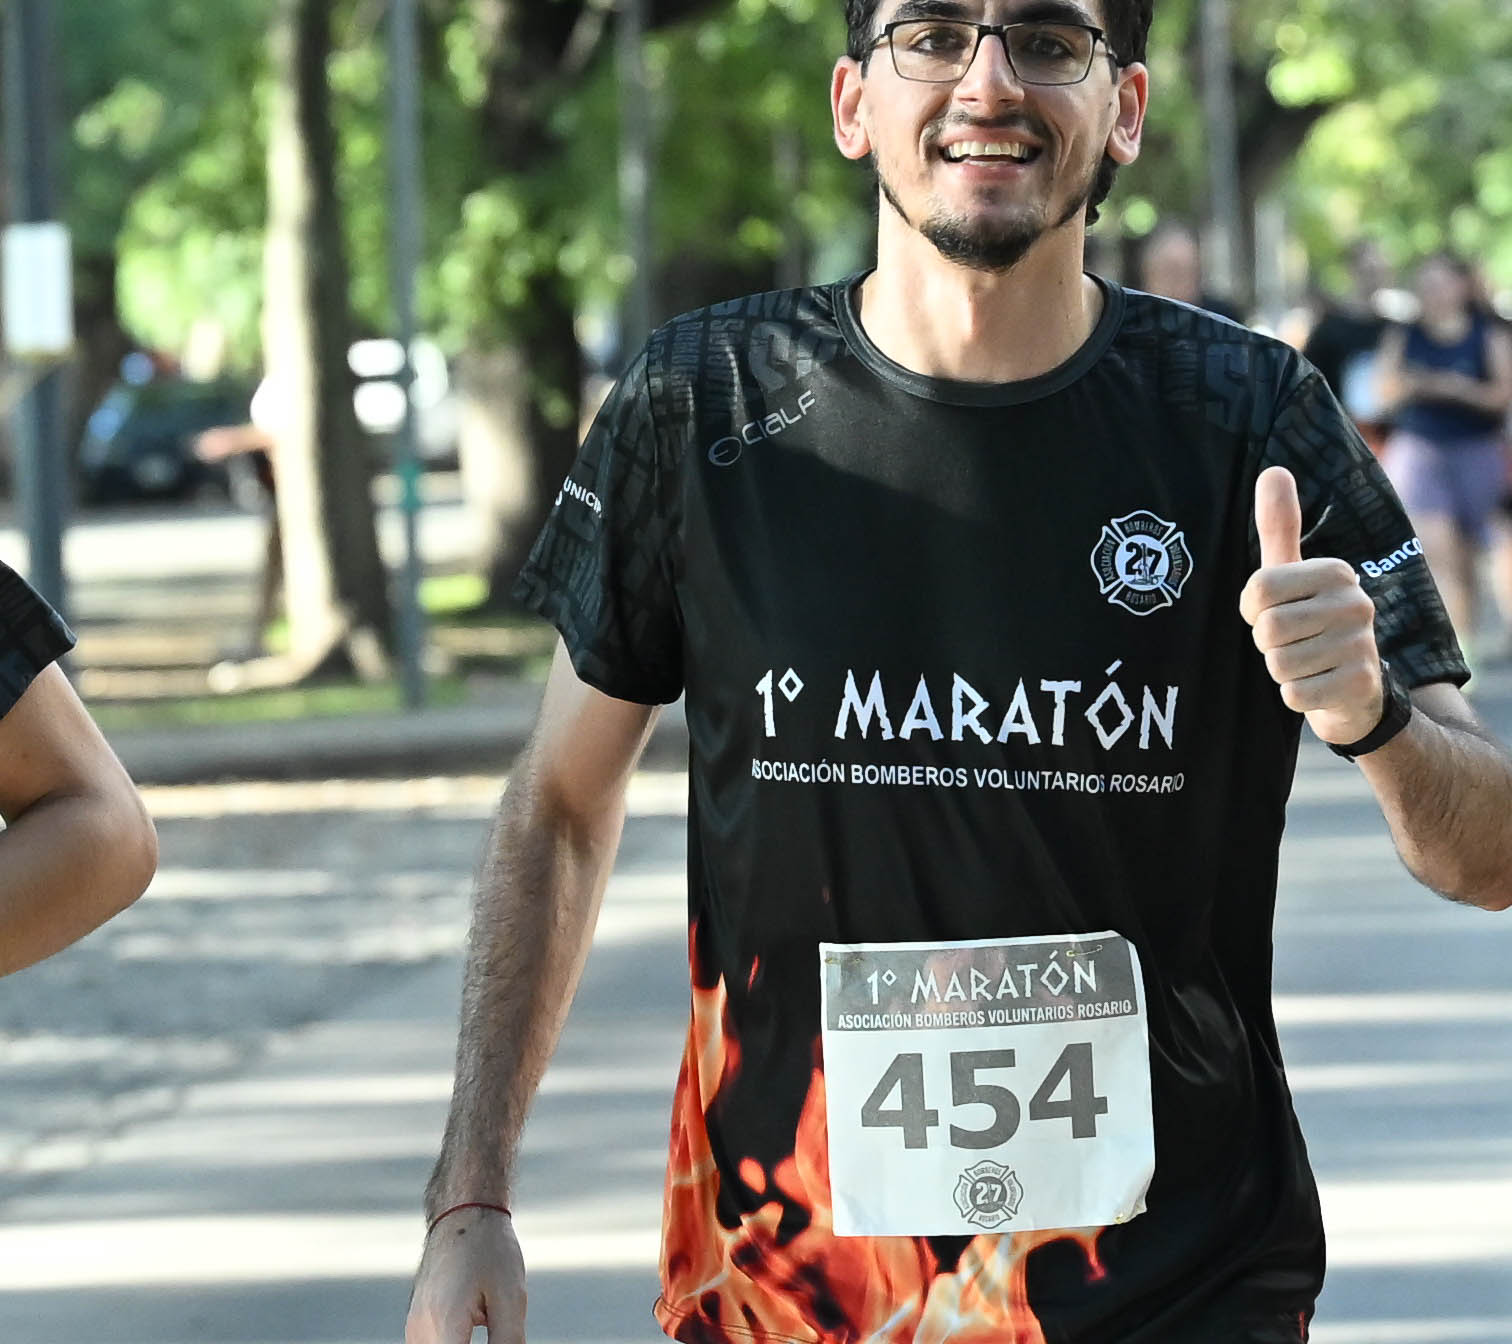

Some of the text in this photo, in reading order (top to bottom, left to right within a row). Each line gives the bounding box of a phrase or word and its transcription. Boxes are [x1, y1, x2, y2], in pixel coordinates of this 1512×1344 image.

[1125, 542, 1163, 575] 27
[834, 659, 1179, 751] MARATÓN
[851, 763, 968, 788] BOMBEROS
[973, 768, 1105, 794] VOLUNTARIOS
[1109, 772, 1185, 794] ROSARIO
[910, 950, 1097, 1004] MARATÓN
[837, 1000, 1133, 1030] ASOCIACIÓN BOMBEROS VOLUNTARIOS ROSARIO
[861, 1041, 1108, 1150] 454
[976, 1181, 1002, 1205] 27
